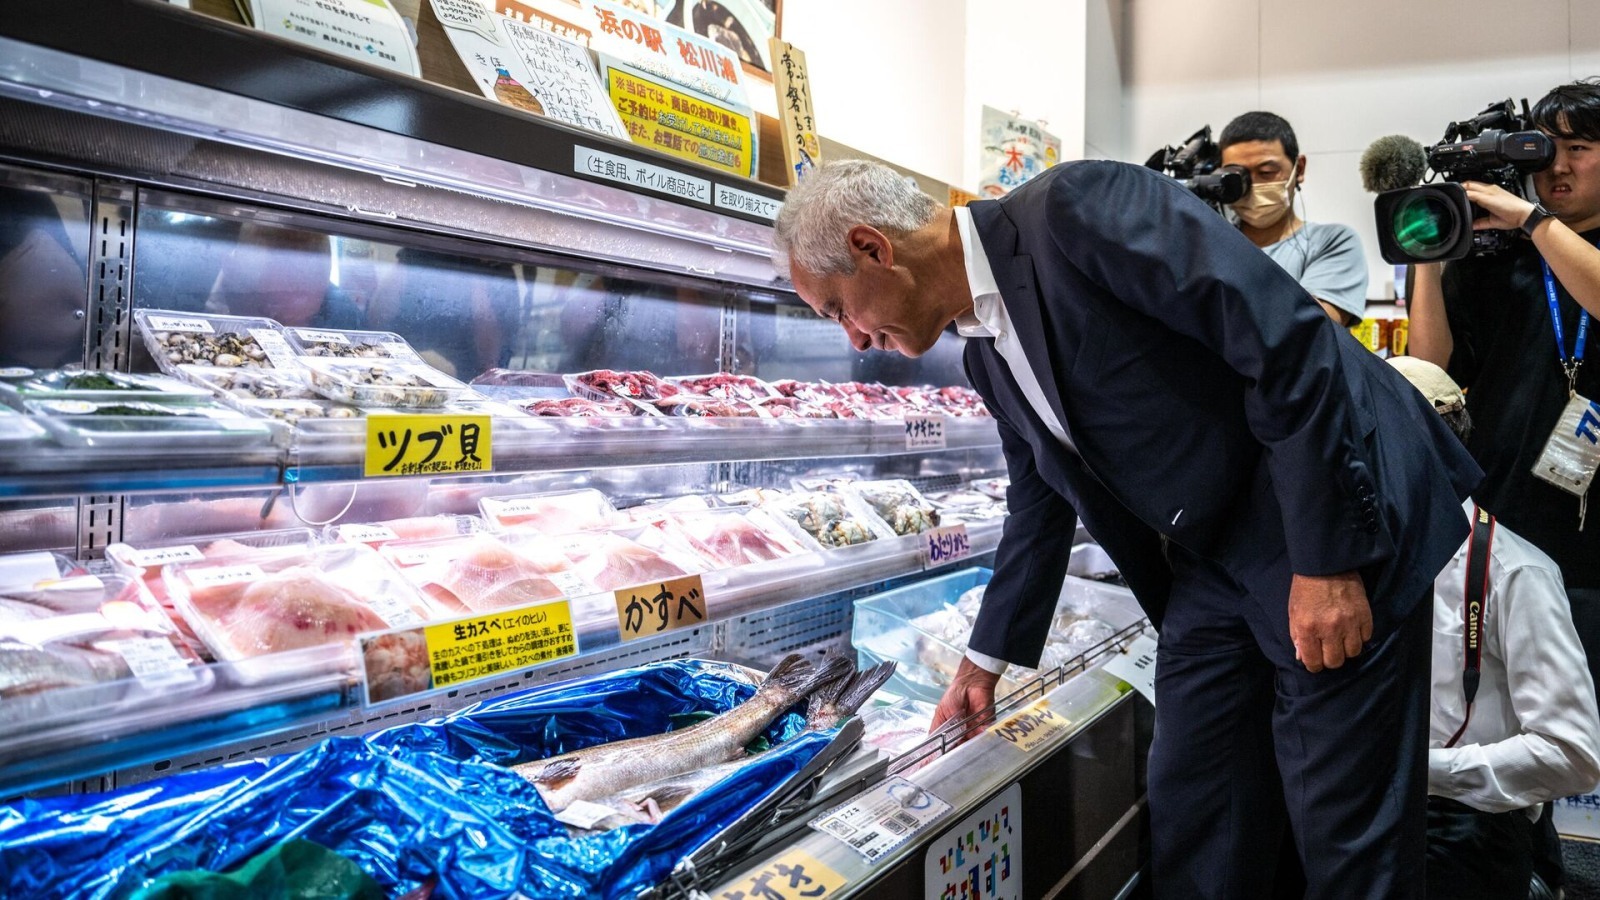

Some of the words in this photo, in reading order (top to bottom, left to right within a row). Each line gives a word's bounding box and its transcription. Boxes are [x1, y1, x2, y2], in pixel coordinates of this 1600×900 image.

[315, 1, 371, 24] ゼロをめざして
[593, 5, 667, 56] 浜の駅
[676, 37, 739, 85] 松川浦
[377, 423, 482, 471] ツブ貝
[625, 584, 702, 633] かすべ
[1469, 601, 1481, 649] Canon
